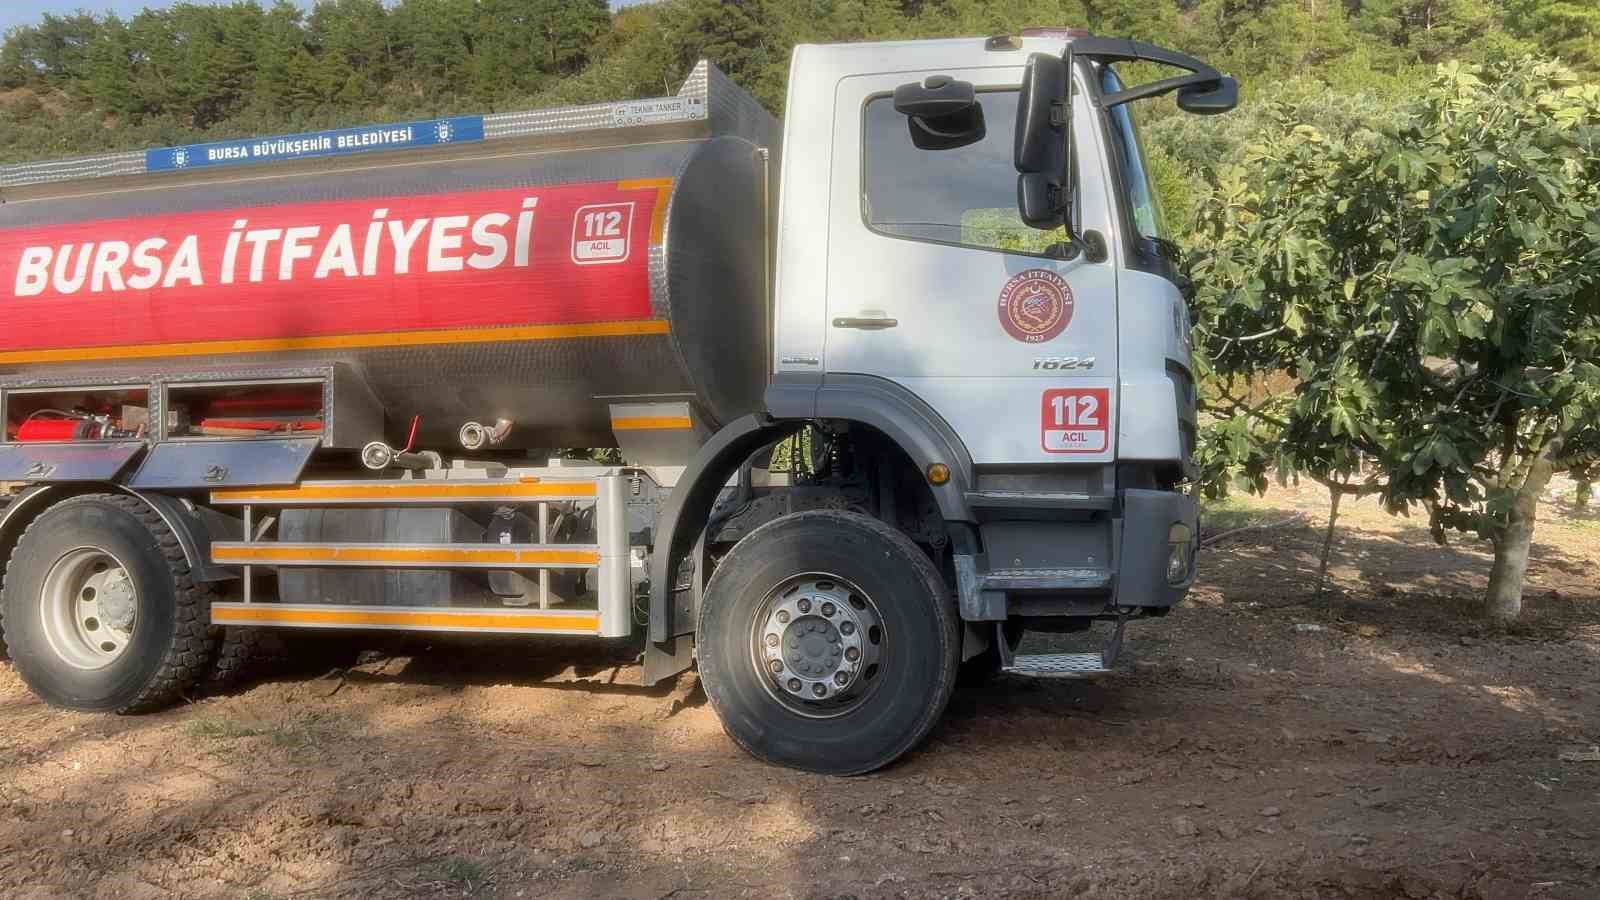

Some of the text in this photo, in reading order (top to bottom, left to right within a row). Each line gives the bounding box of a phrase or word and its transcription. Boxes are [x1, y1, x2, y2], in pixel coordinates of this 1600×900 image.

[208, 126, 413, 160] BURSA BÜYÜKŞEHİR BELEDİYESİ
[584, 210, 622, 237] 112
[14, 196, 539, 297] BURSA İTFAİYESİ
[1051, 395, 1099, 425] 112
